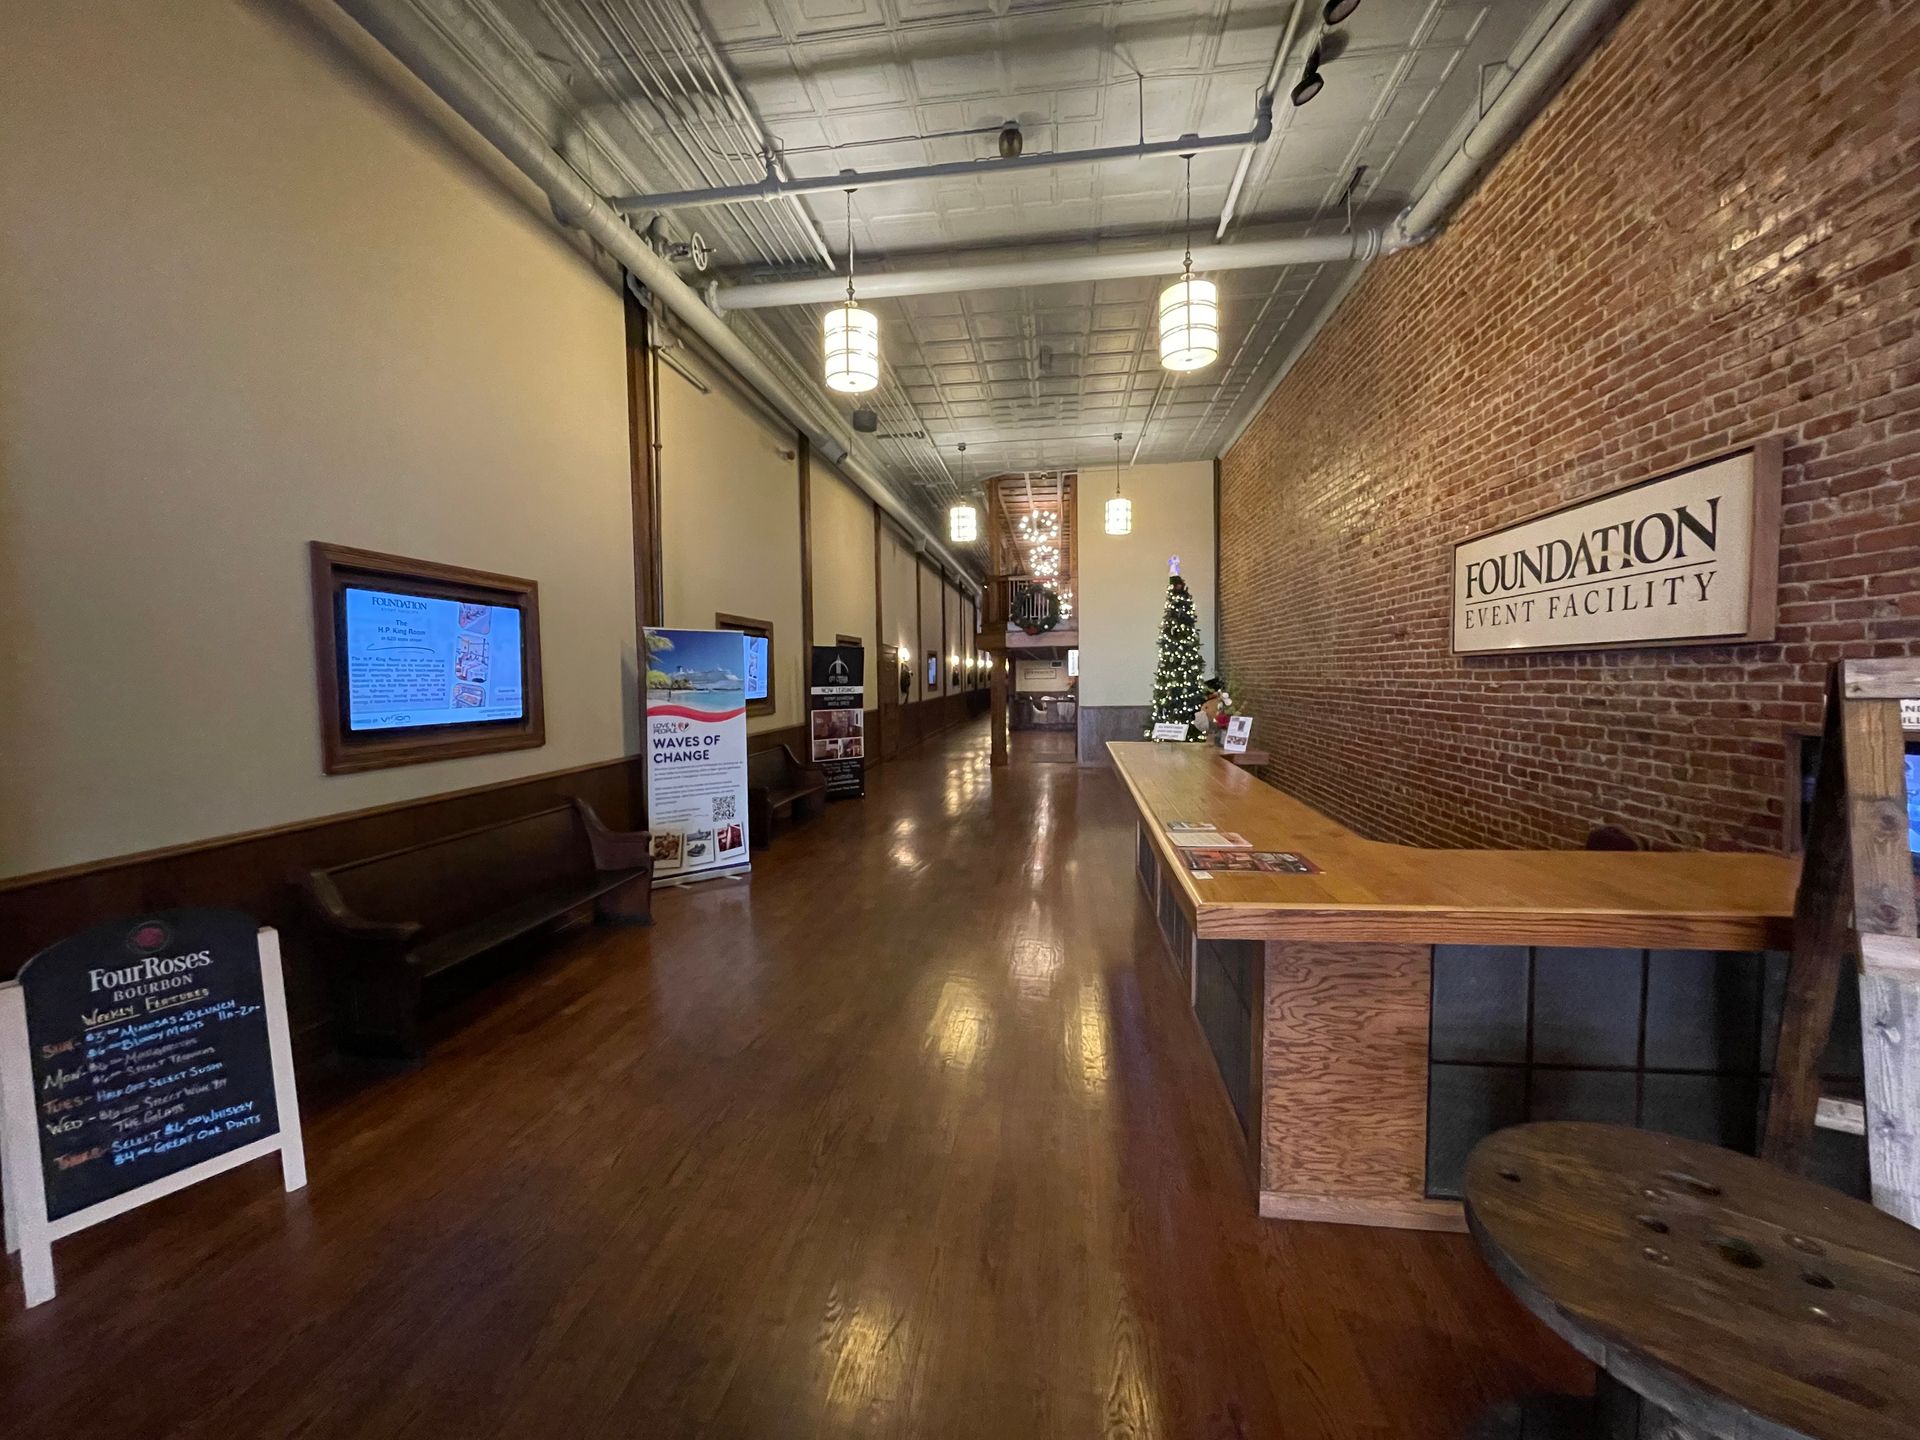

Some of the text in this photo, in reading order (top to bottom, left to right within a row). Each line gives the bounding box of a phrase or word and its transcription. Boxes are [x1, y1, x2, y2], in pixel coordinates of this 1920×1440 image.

[1466, 496, 1721, 598] FOUNDATION
[372, 597, 427, 610] FOUNDATION
[1465, 571, 1717, 629] EVENT FACILITY
[653, 735, 721, 749] WAVES OF
[653, 750, 710, 764] CHANGE
[113, 973, 193, 1002] BOURBON
